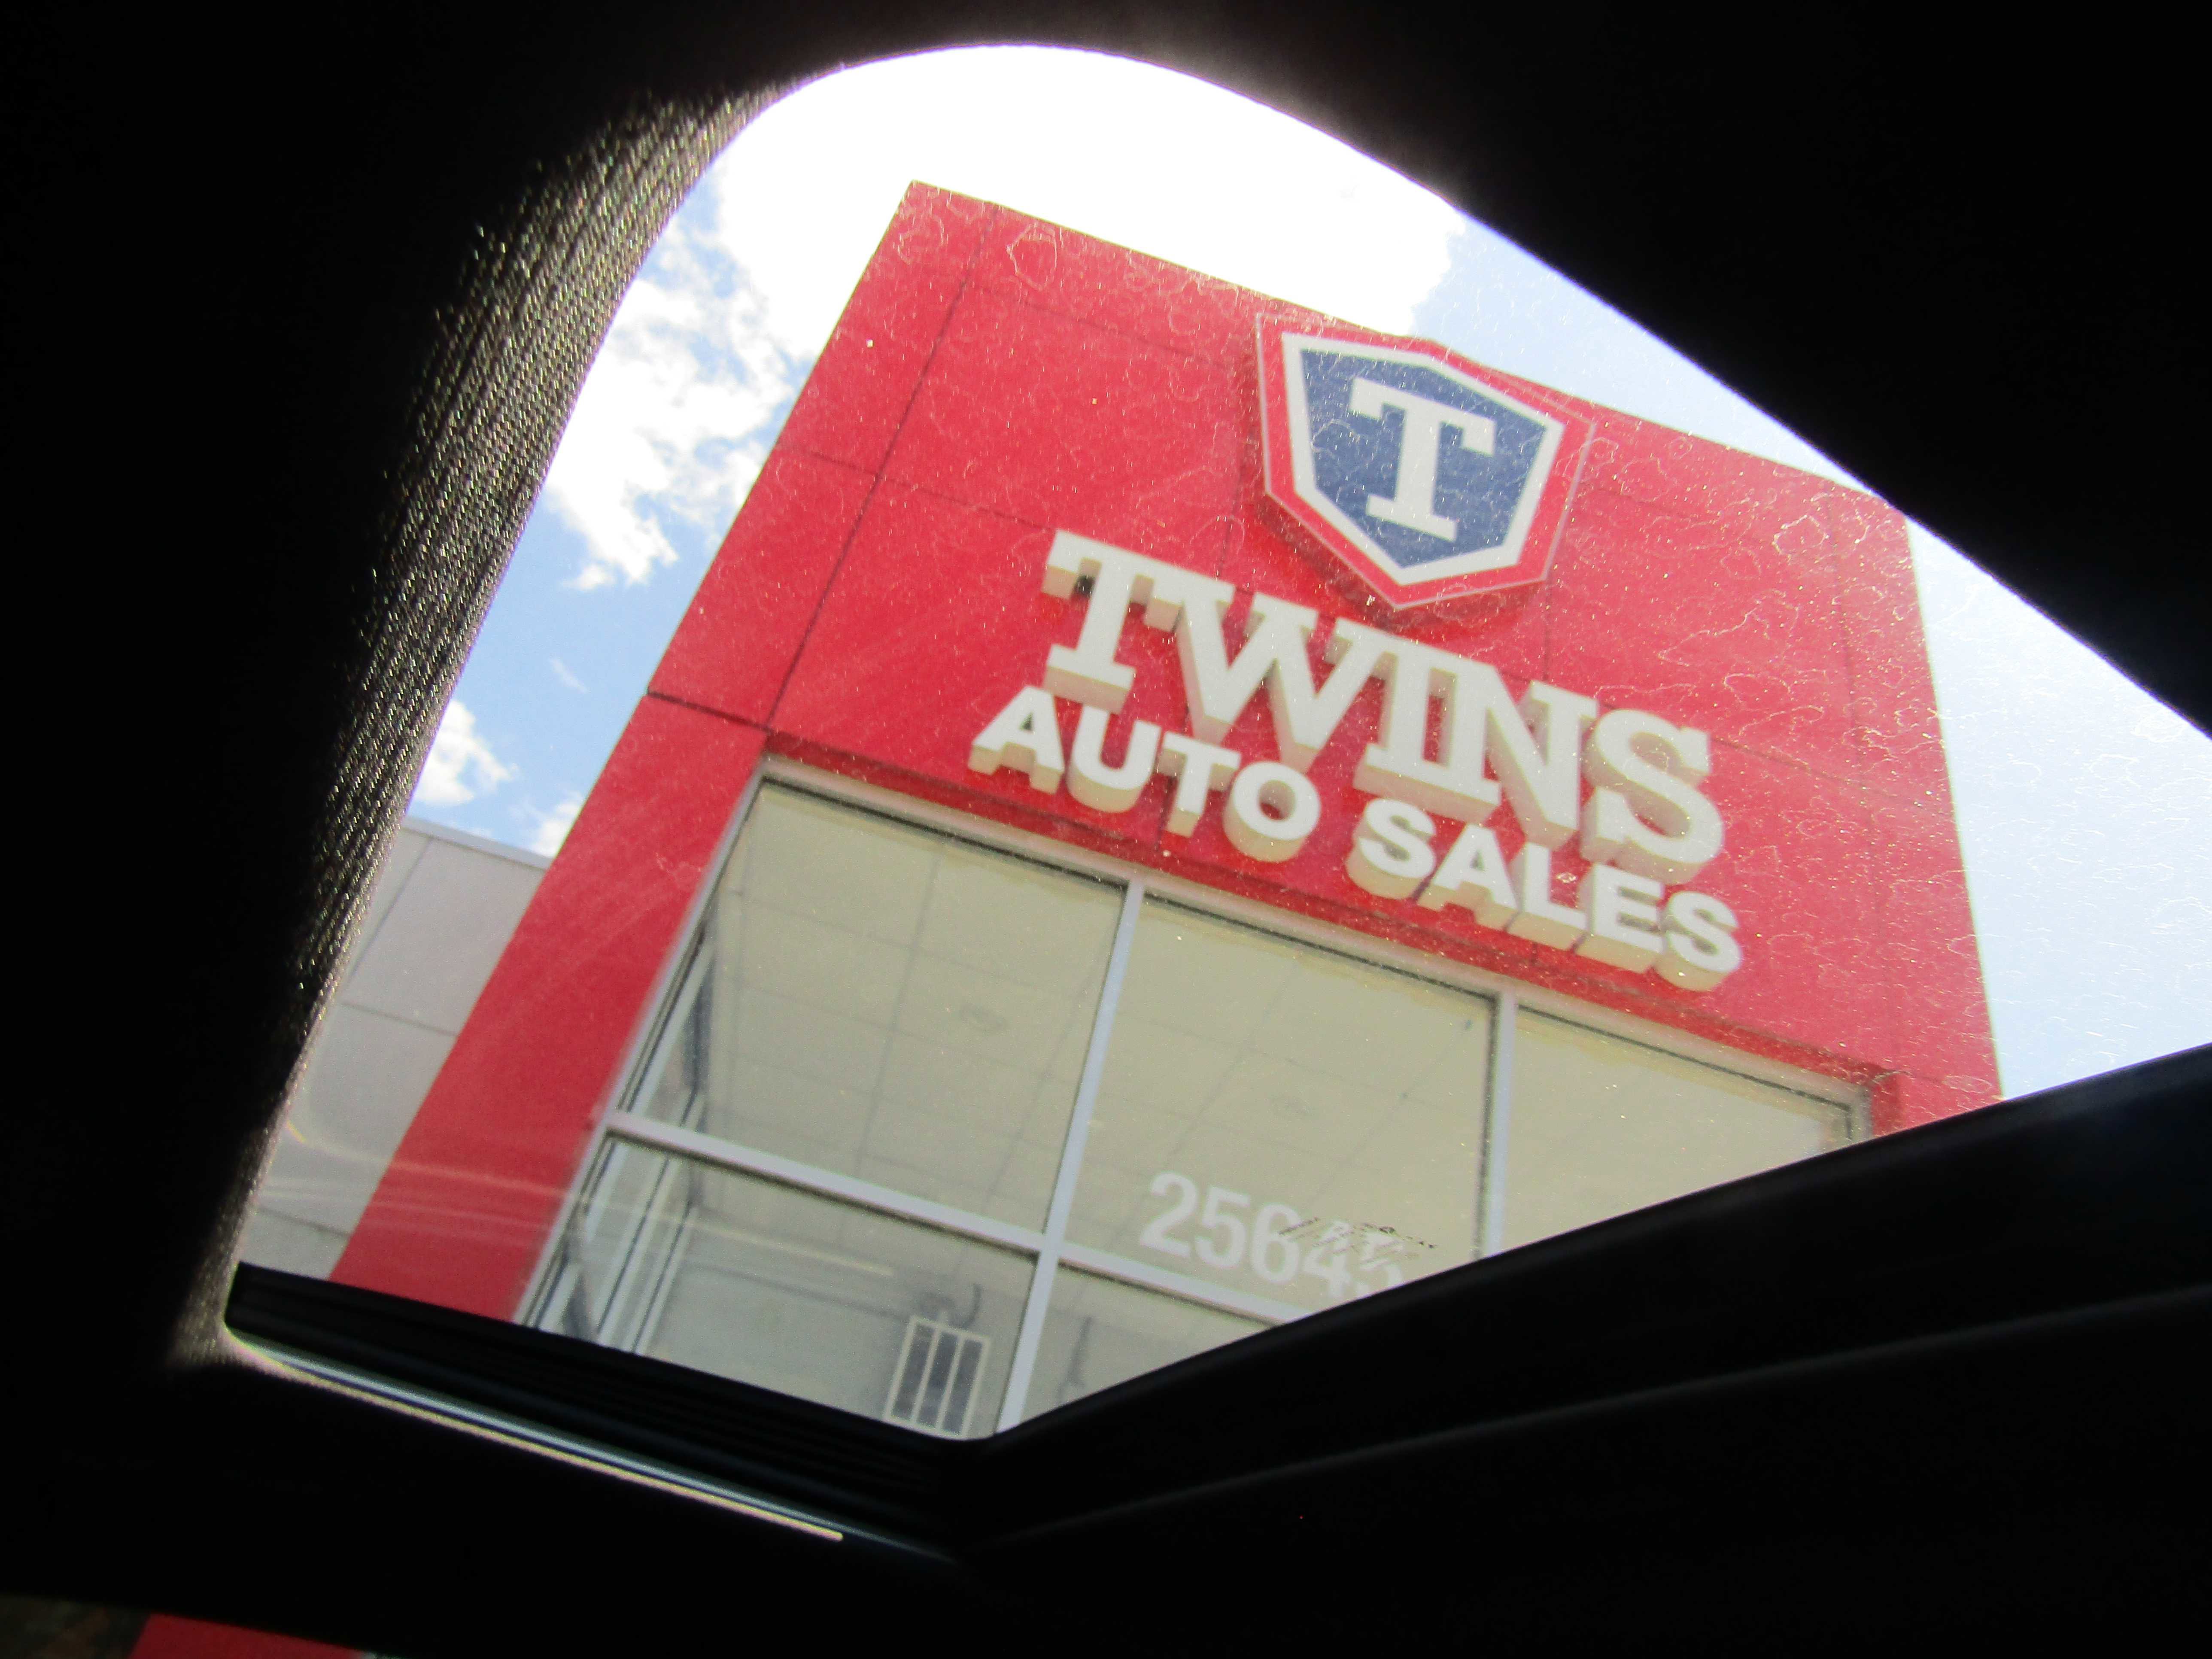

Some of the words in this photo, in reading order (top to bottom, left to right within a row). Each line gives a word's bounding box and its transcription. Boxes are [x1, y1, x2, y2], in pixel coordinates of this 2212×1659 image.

[1349, 377, 1496, 543] T
[969, 686, 1321, 859] AUTO
[1346, 799, 1742, 989] SALES
[1044, 531, 1723, 880] TWINS
